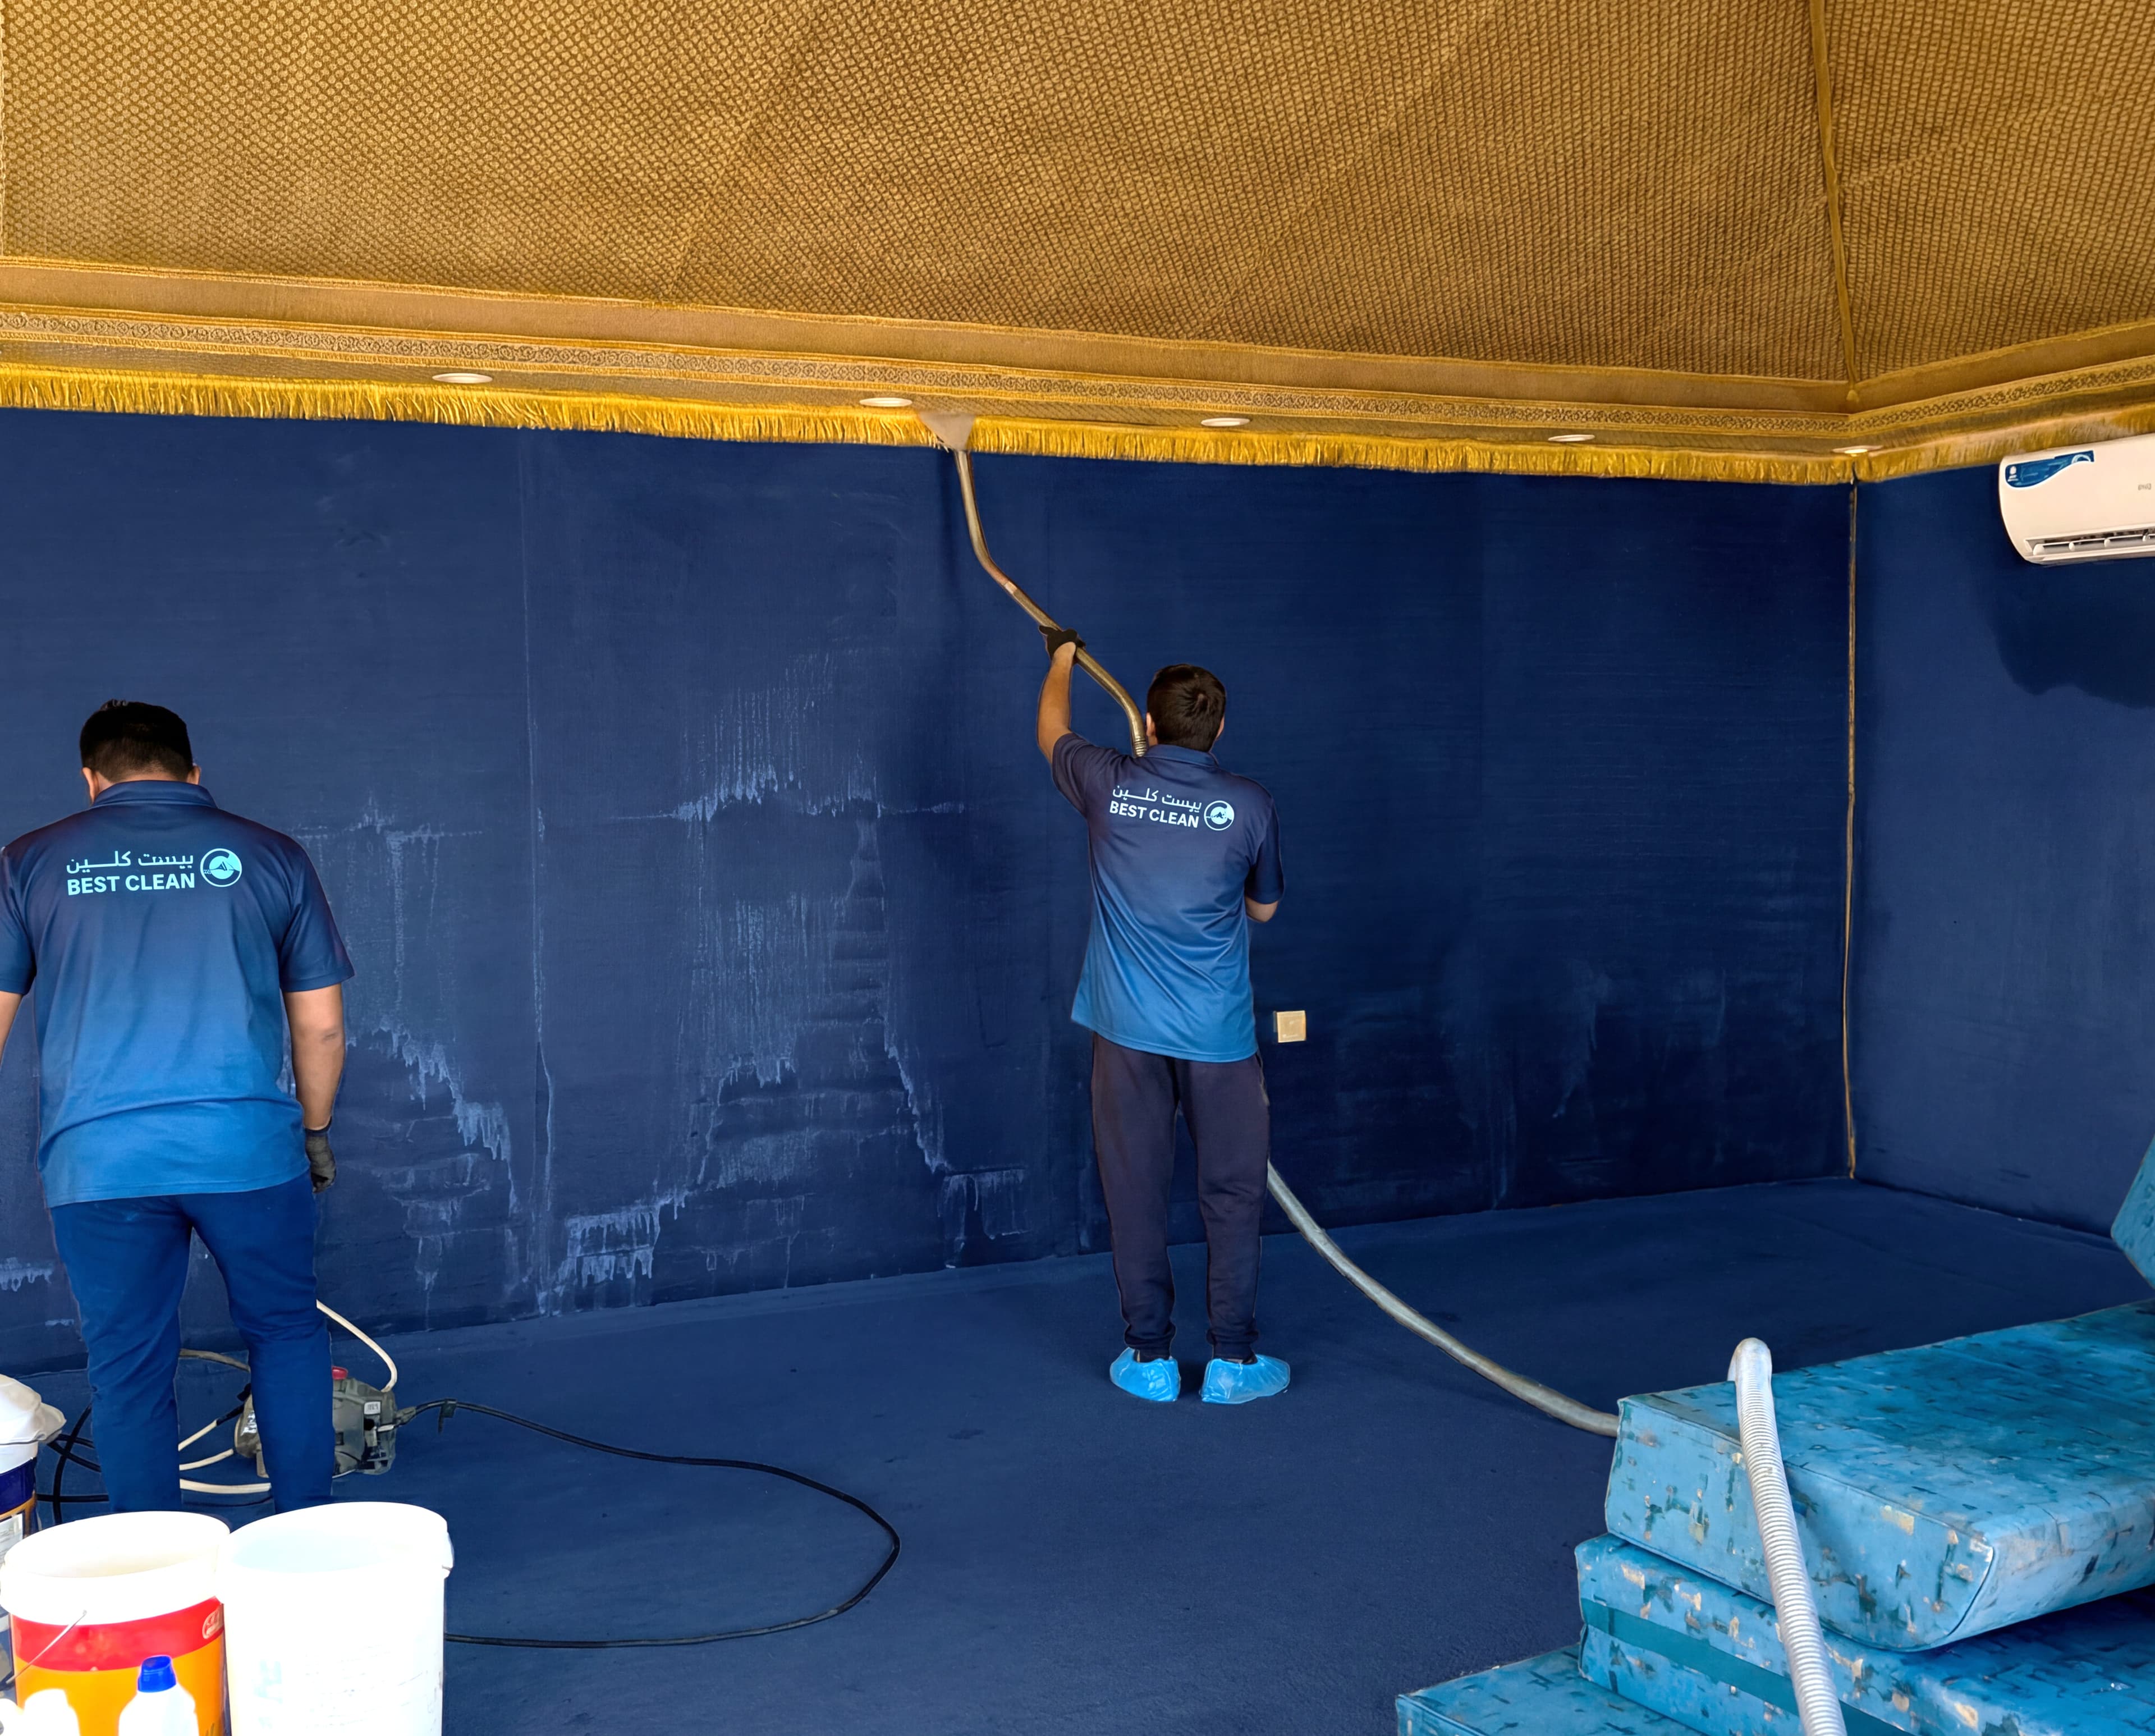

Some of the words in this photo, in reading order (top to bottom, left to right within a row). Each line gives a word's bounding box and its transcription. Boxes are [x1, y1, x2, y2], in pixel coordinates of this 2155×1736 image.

[1109, 800, 1148, 819] BEST
[1149, 808, 1199, 828] CLEAN
[1161, 794, 1202, 813] بيست
[137, 853, 194, 869] بيست
[67, 876, 120, 896] BEST
[125, 872, 195, 891] CLEAN
